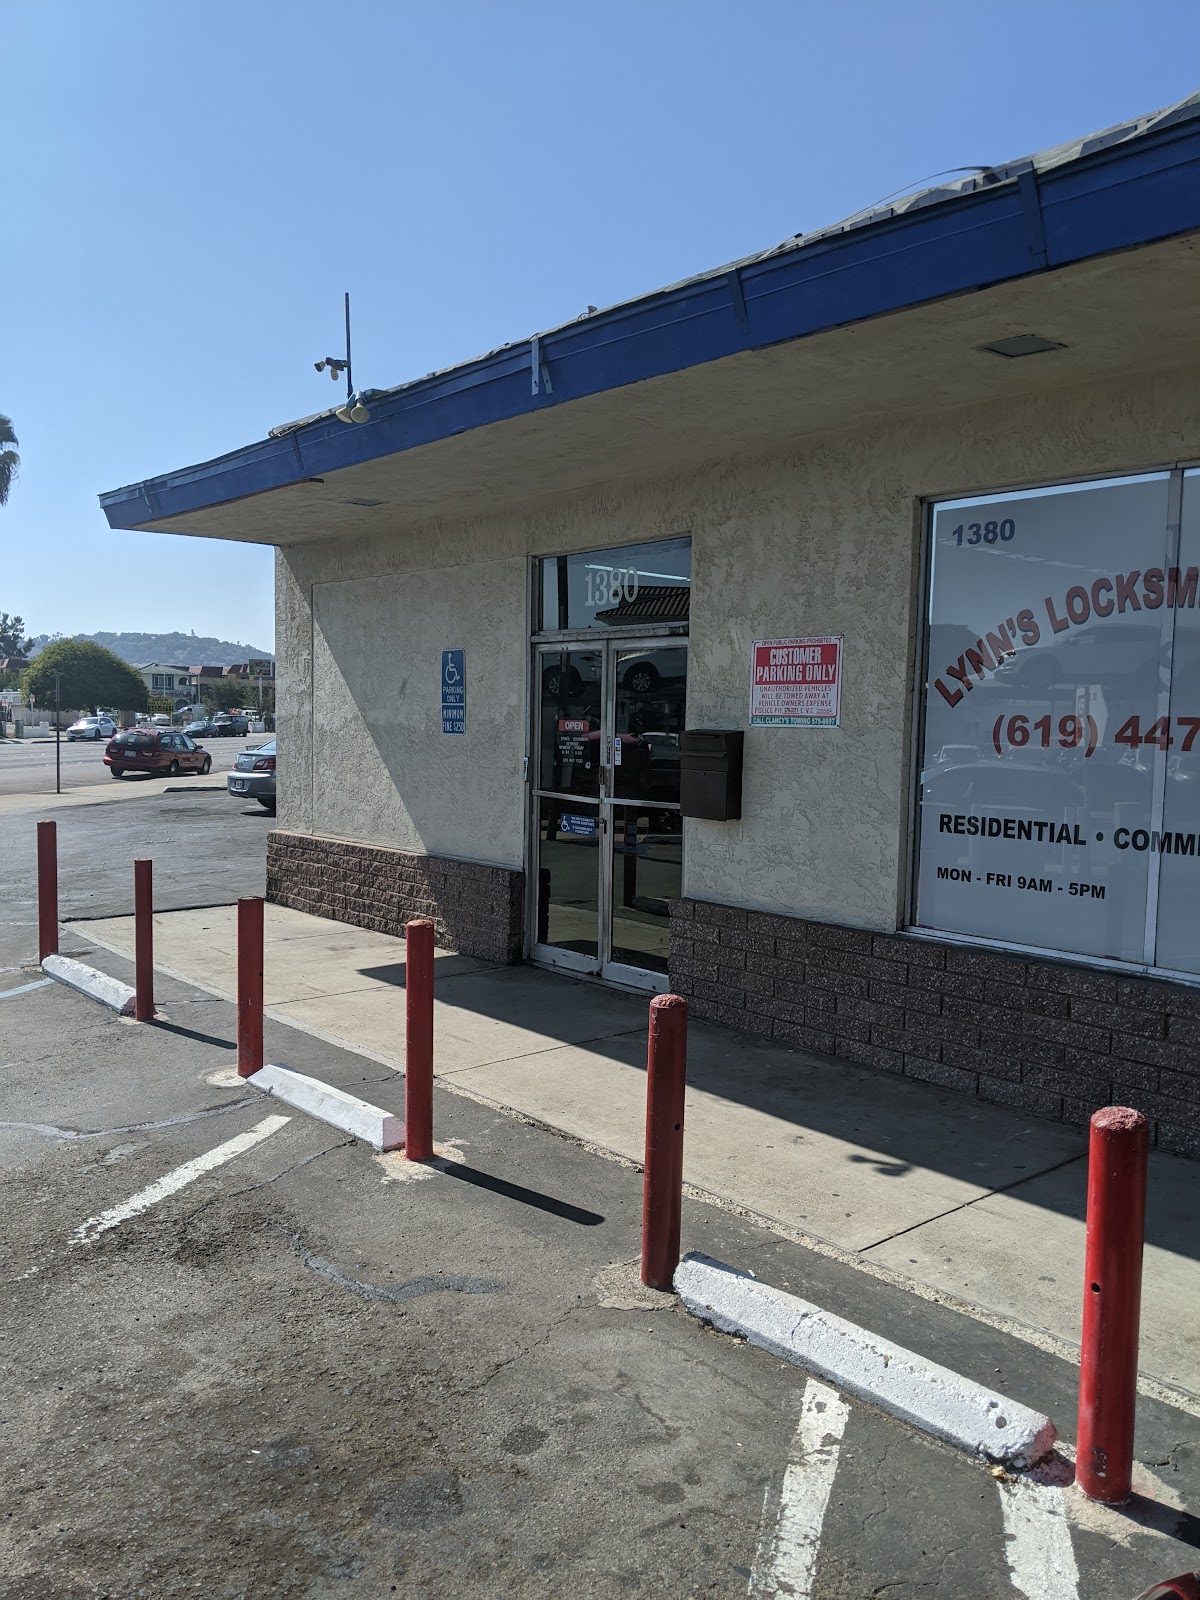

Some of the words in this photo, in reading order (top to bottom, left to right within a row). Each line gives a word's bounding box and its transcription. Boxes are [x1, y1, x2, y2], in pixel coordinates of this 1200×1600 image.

[952, 518, 1016, 547] 1380
[584, 566, 639, 607] 1380
[933, 608, 1041, 709] LYNN'S
[1045, 566, 1200, 634] LOCKSM
[769, 647, 822, 665] CUSTOMER
[757, 665, 803, 682] PARKING
[806, 664, 835, 681] ONLY
[443, 686, 464, 694] PARKING
[446, 694, 460, 702] ONLY
[443, 709, 464, 719] MINIMUM
[443, 721, 453, 731] FINE
[564, 721, 584, 730] OPEN
[992, 714, 1099, 758] (619)
[939, 813, 1087, 846] RESIDENTIAL
[1113, 827, 1200, 857] COMM
[937, 866, 972, 883] MON
[986, 872, 1012, 888] FRI
[1017, 875, 1053, 893] 9AM
[1068, 882, 1106, 899] 5PM
